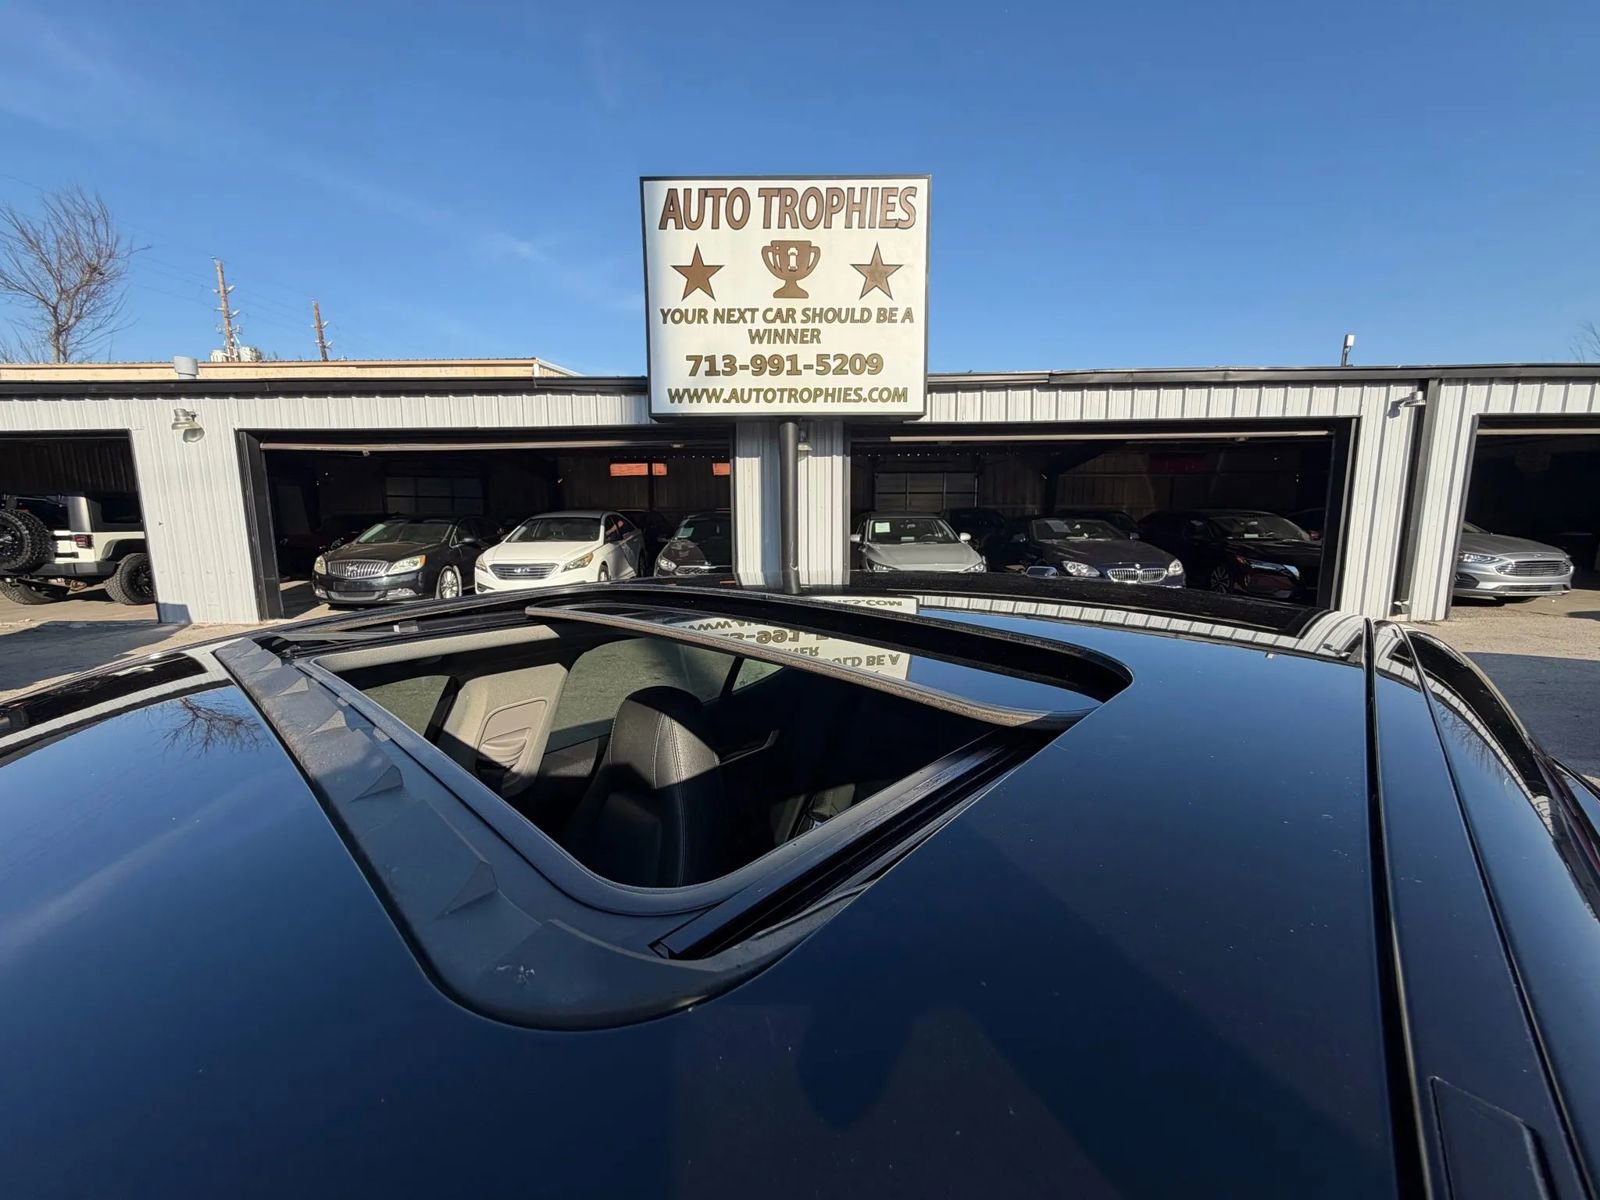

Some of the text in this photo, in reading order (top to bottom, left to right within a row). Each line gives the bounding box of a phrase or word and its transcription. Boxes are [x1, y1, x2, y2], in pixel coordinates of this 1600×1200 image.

[658, 186, 918, 231] AUTO TROPHIES
[660, 307, 914, 324] YOUR NEXT CAR SHOULD BE A
[747, 328, 821, 345] WINNER
[685, 352, 884, 377] 713-991-5209
[667, 386, 908, 404] WWW.AUTOTROPHIES.COM
